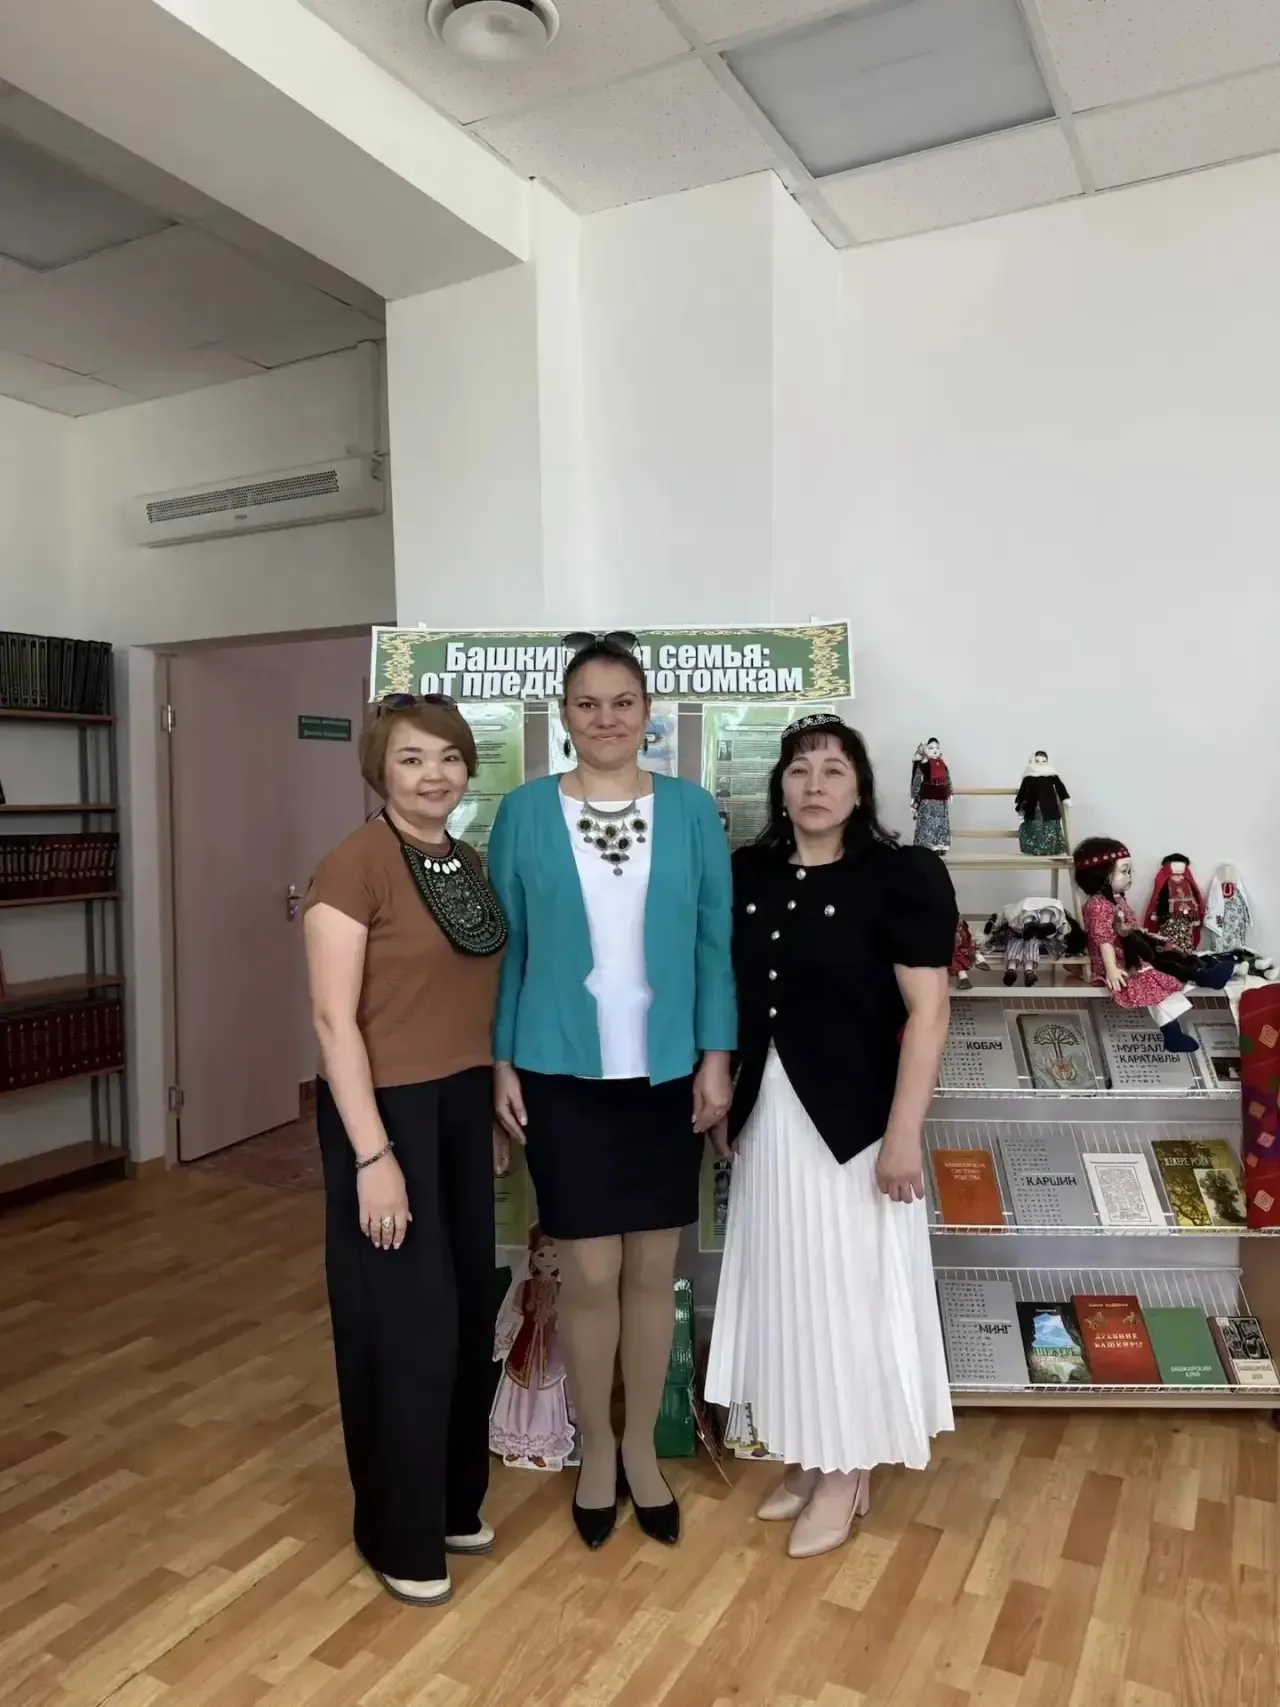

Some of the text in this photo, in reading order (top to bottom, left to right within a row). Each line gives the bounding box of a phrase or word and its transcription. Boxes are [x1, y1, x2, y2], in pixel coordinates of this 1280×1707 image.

[446, 642, 771, 672] Башкиря семья:
[420, 667, 803, 699] от предк потомкам
[1131, 1033, 1164, 1042] КУДЕ
[1119, 1053, 1181, 1064] КАРАТАВЛЫ
[1025, 1176, 1078, 1186] КАРШИН
[979, 1324, 1012, 1334] МИНГ
[1094, 1341, 1143, 1349] БАШКИРЫ
